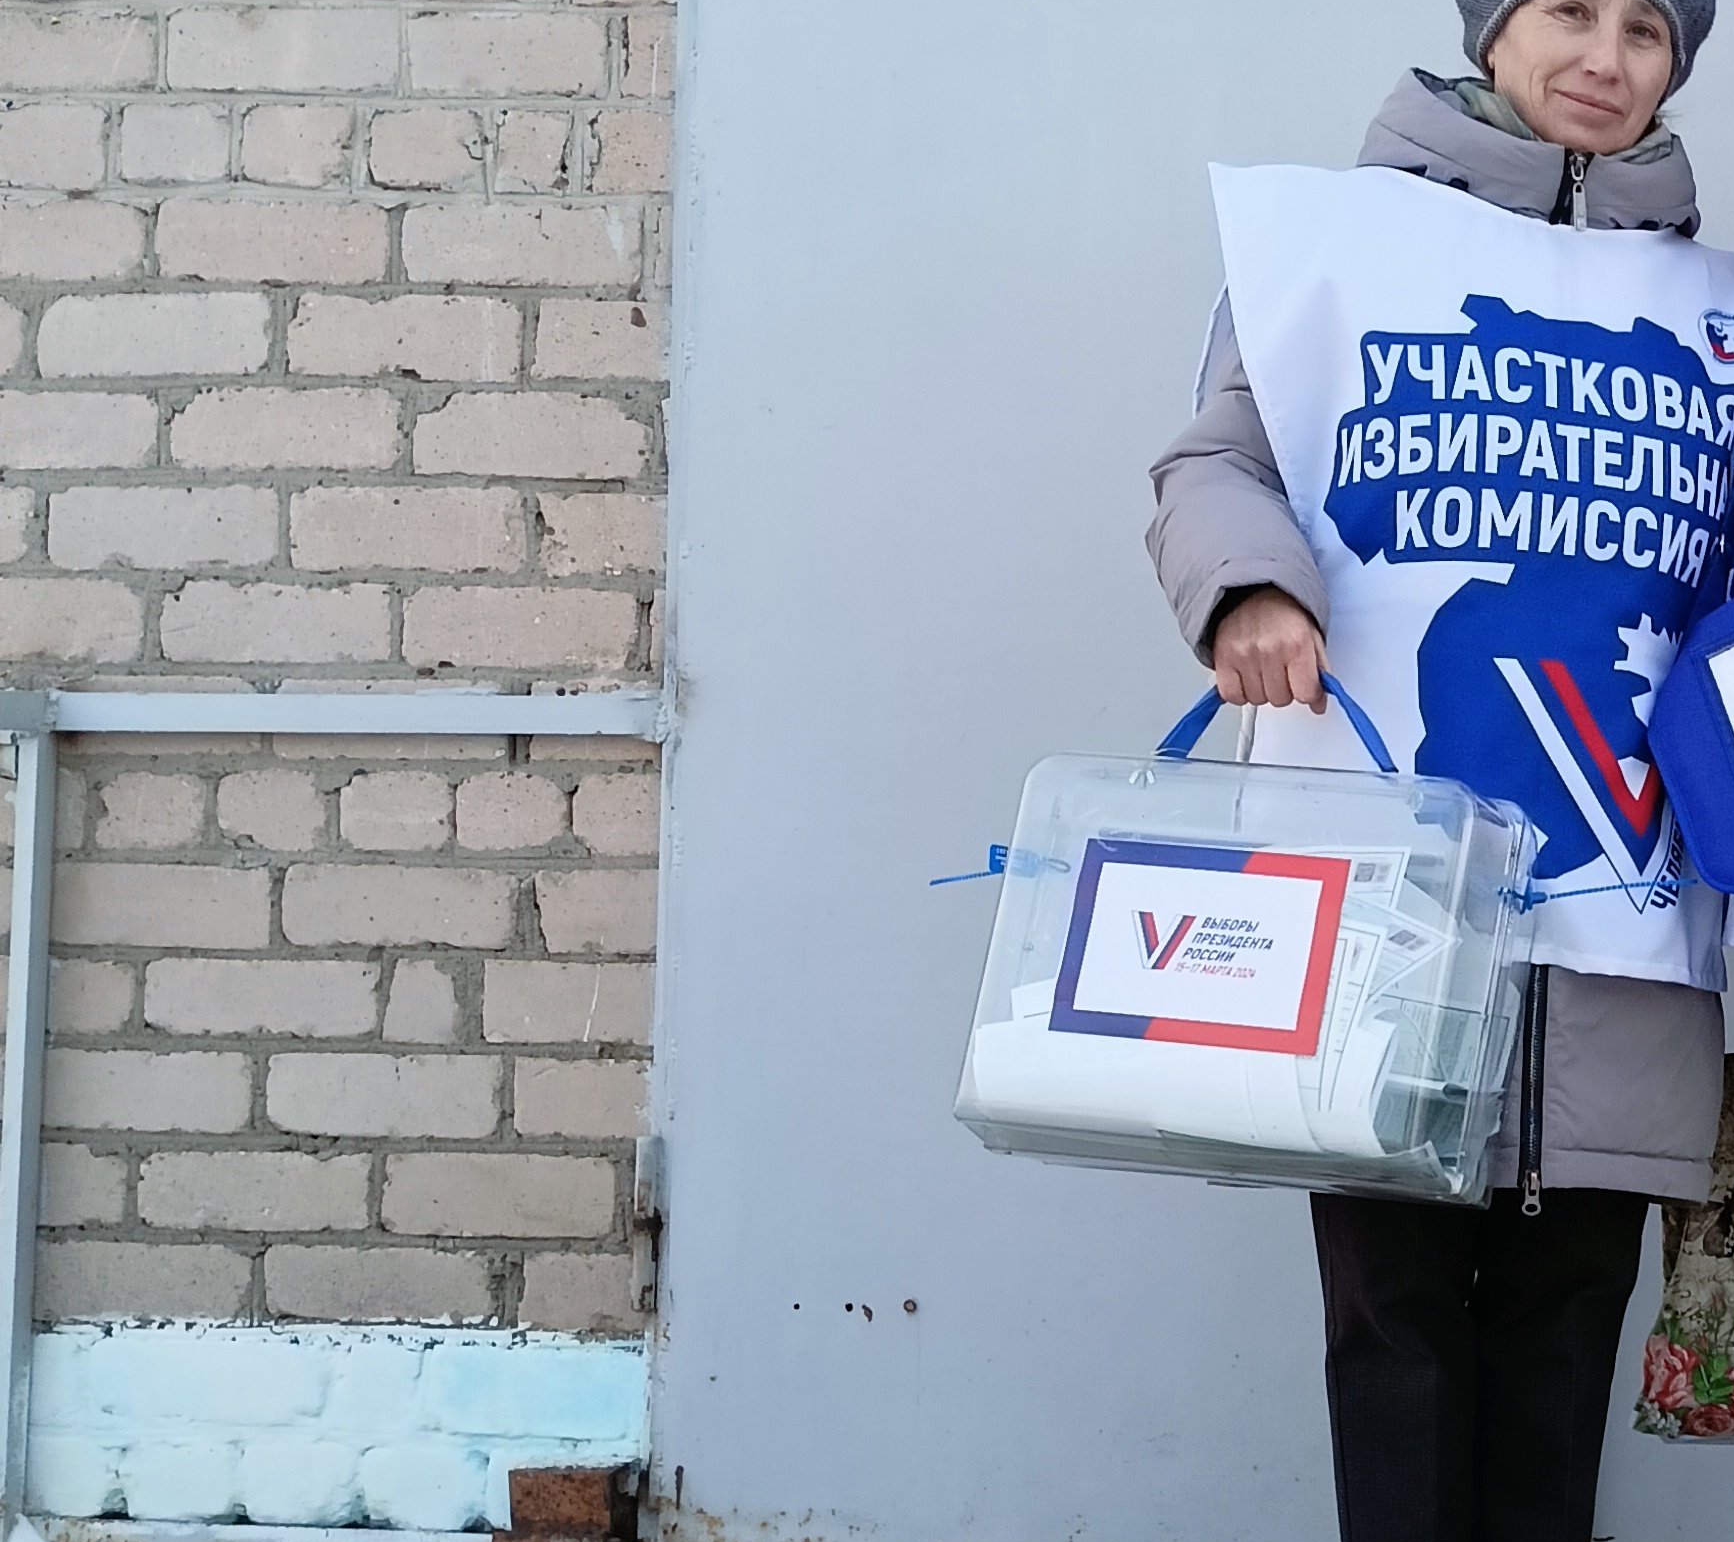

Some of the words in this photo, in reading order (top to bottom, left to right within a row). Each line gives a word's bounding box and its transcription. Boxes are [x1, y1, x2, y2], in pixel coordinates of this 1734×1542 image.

[1396, 486, 1710, 589] КОМИССИЯ
[1201, 916, 1260, 933] ВЫБОРЫ
[1192, 932, 1274, 950] ПРЕЗИДЕНТА
[1182, 947, 1236, 962] РОССИИ
[1200, 964, 1232, 977] МАРТА
